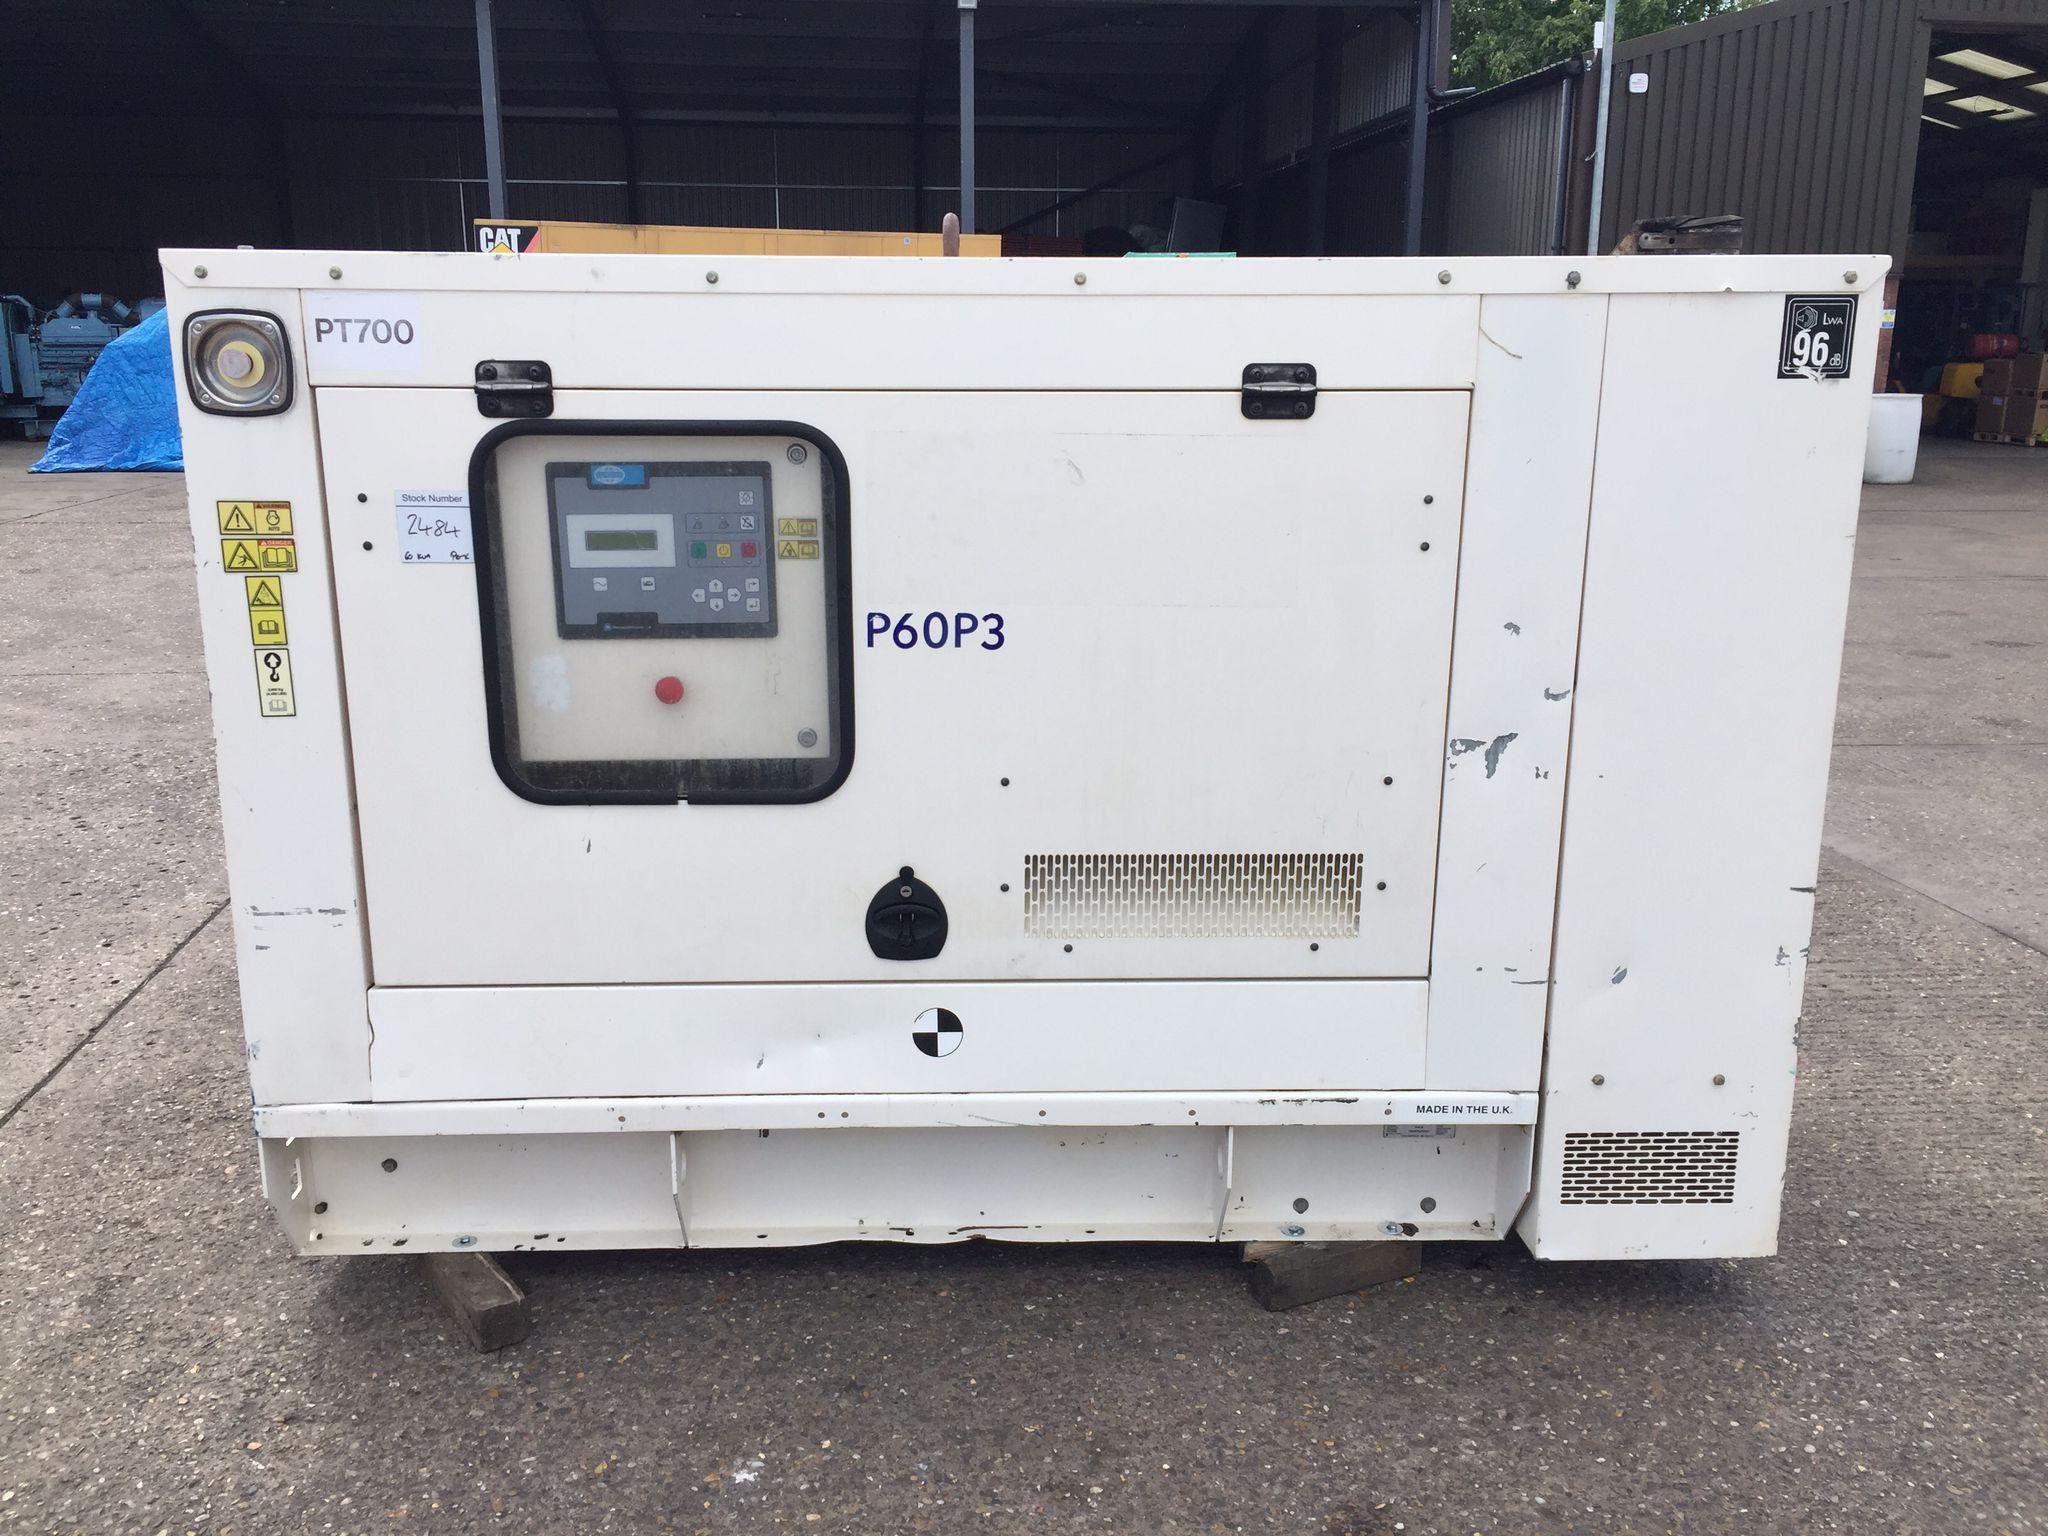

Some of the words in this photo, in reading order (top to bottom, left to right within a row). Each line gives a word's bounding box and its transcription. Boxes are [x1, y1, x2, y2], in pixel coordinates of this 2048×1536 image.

[479, 226, 521, 253] CAT
[314, 317, 414, 345] PT700
[1792, 330, 1830, 367] 96
[1829, 353, 1842, 366] dB
[402, 493, 427, 503] Stock
[428, 494, 463, 503] Number
[407, 513, 462, 538] 2484
[866, 611, 1006, 651] P60P3
[1416, 1105, 1449, 1114] MADE
[1452, 1105, 1463, 1114] IN
[1467, 1105, 1489, 1115] THE
[1492, 1105, 1513, 1115] U.K.
